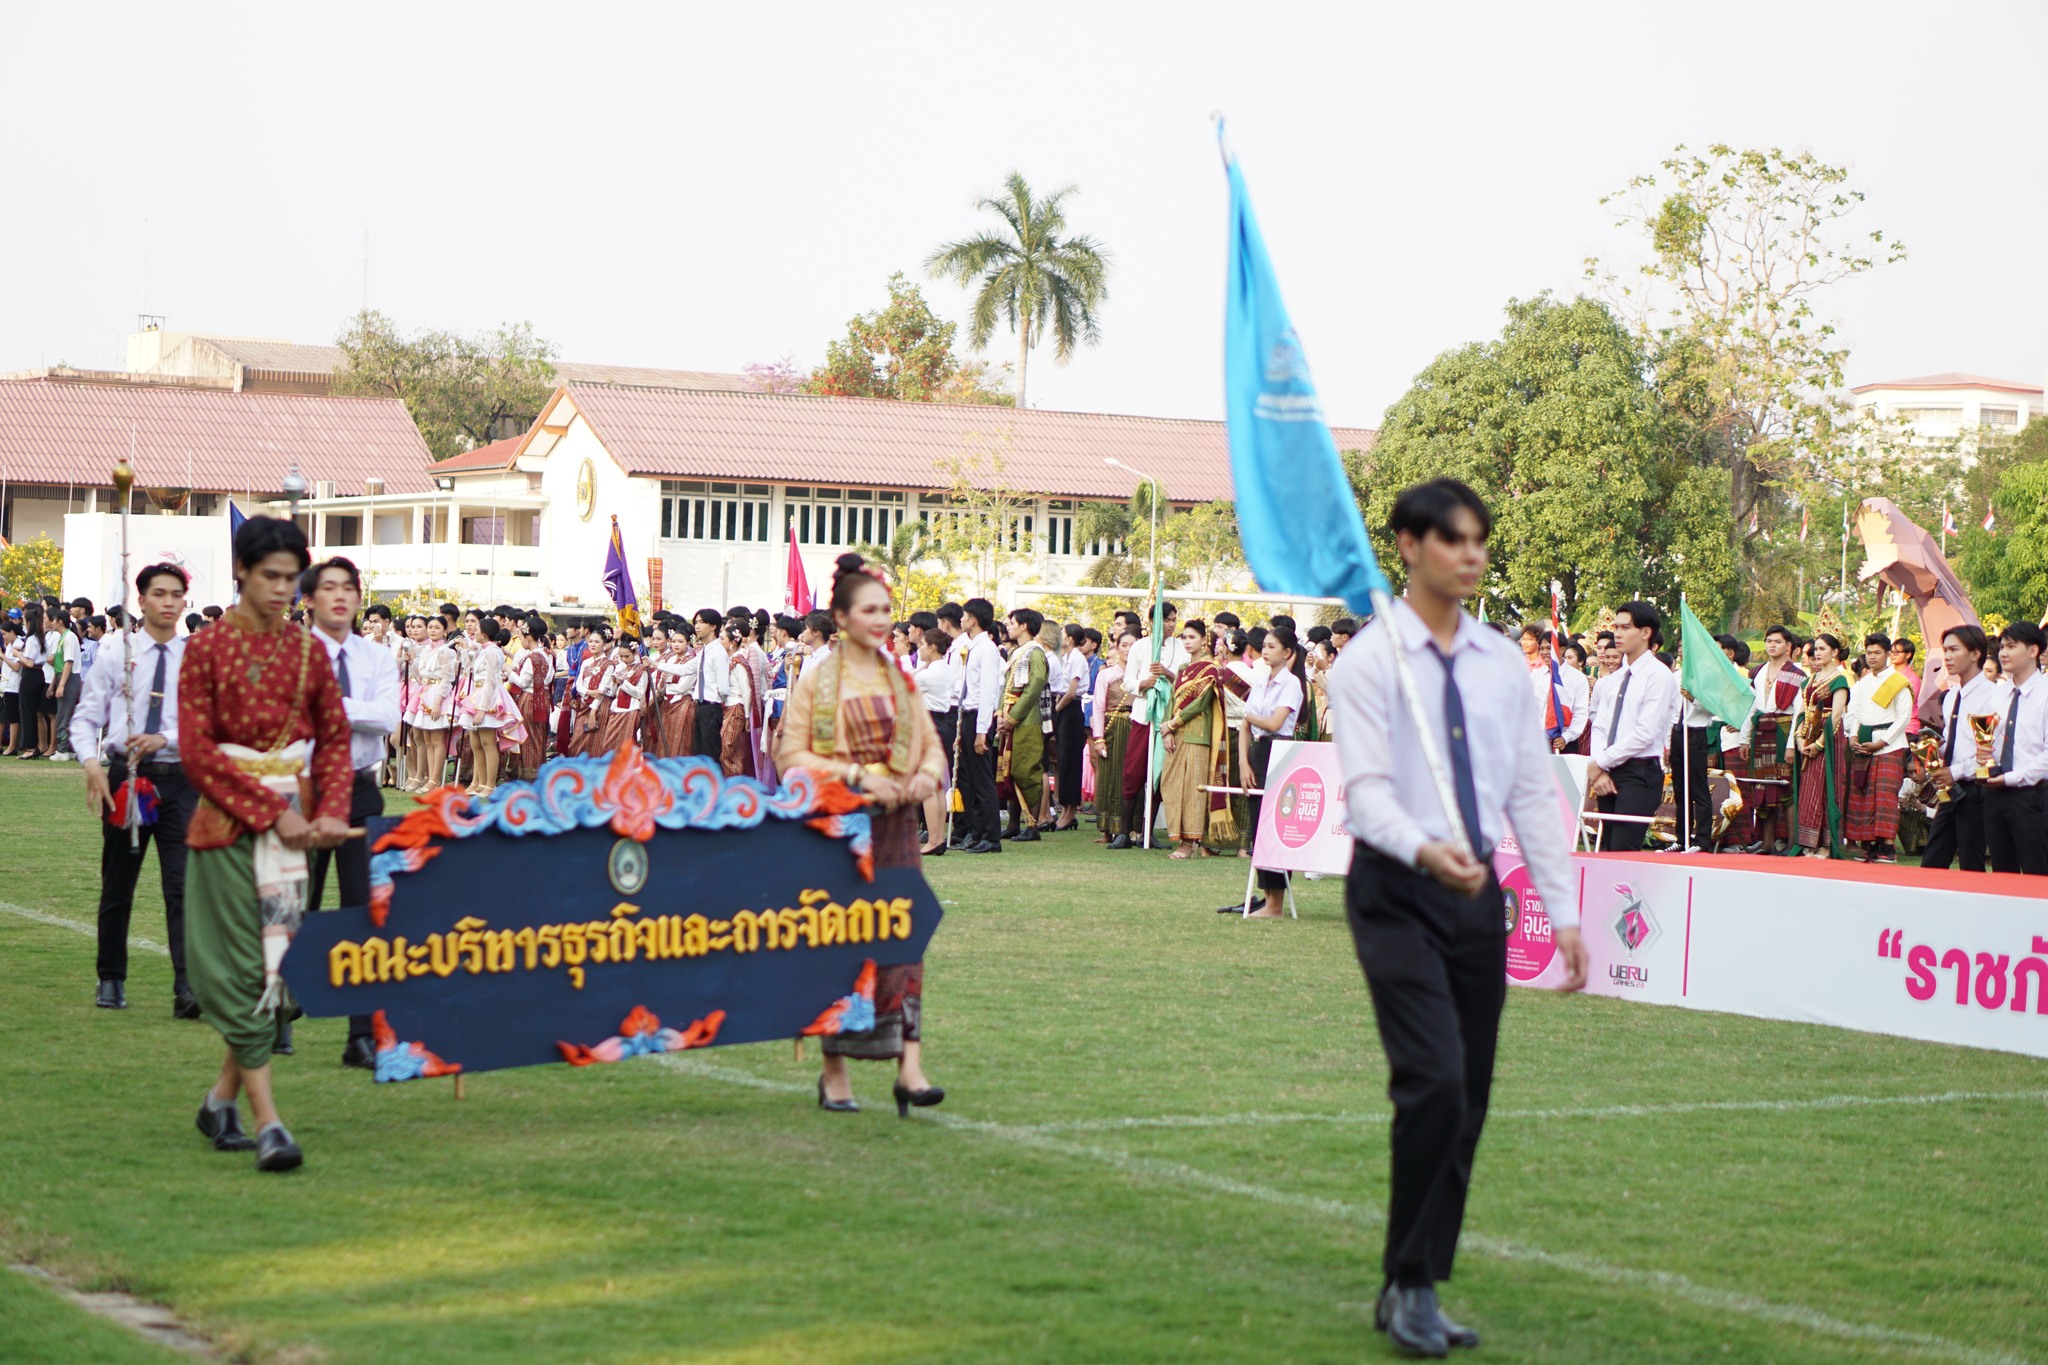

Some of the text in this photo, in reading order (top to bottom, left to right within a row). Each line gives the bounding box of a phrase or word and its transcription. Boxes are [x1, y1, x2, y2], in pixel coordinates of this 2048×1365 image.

[329, 888, 913, 990] คณะบริหารธุรกิจและการจัดการ
[1609, 963, 1648, 982] UBRU
